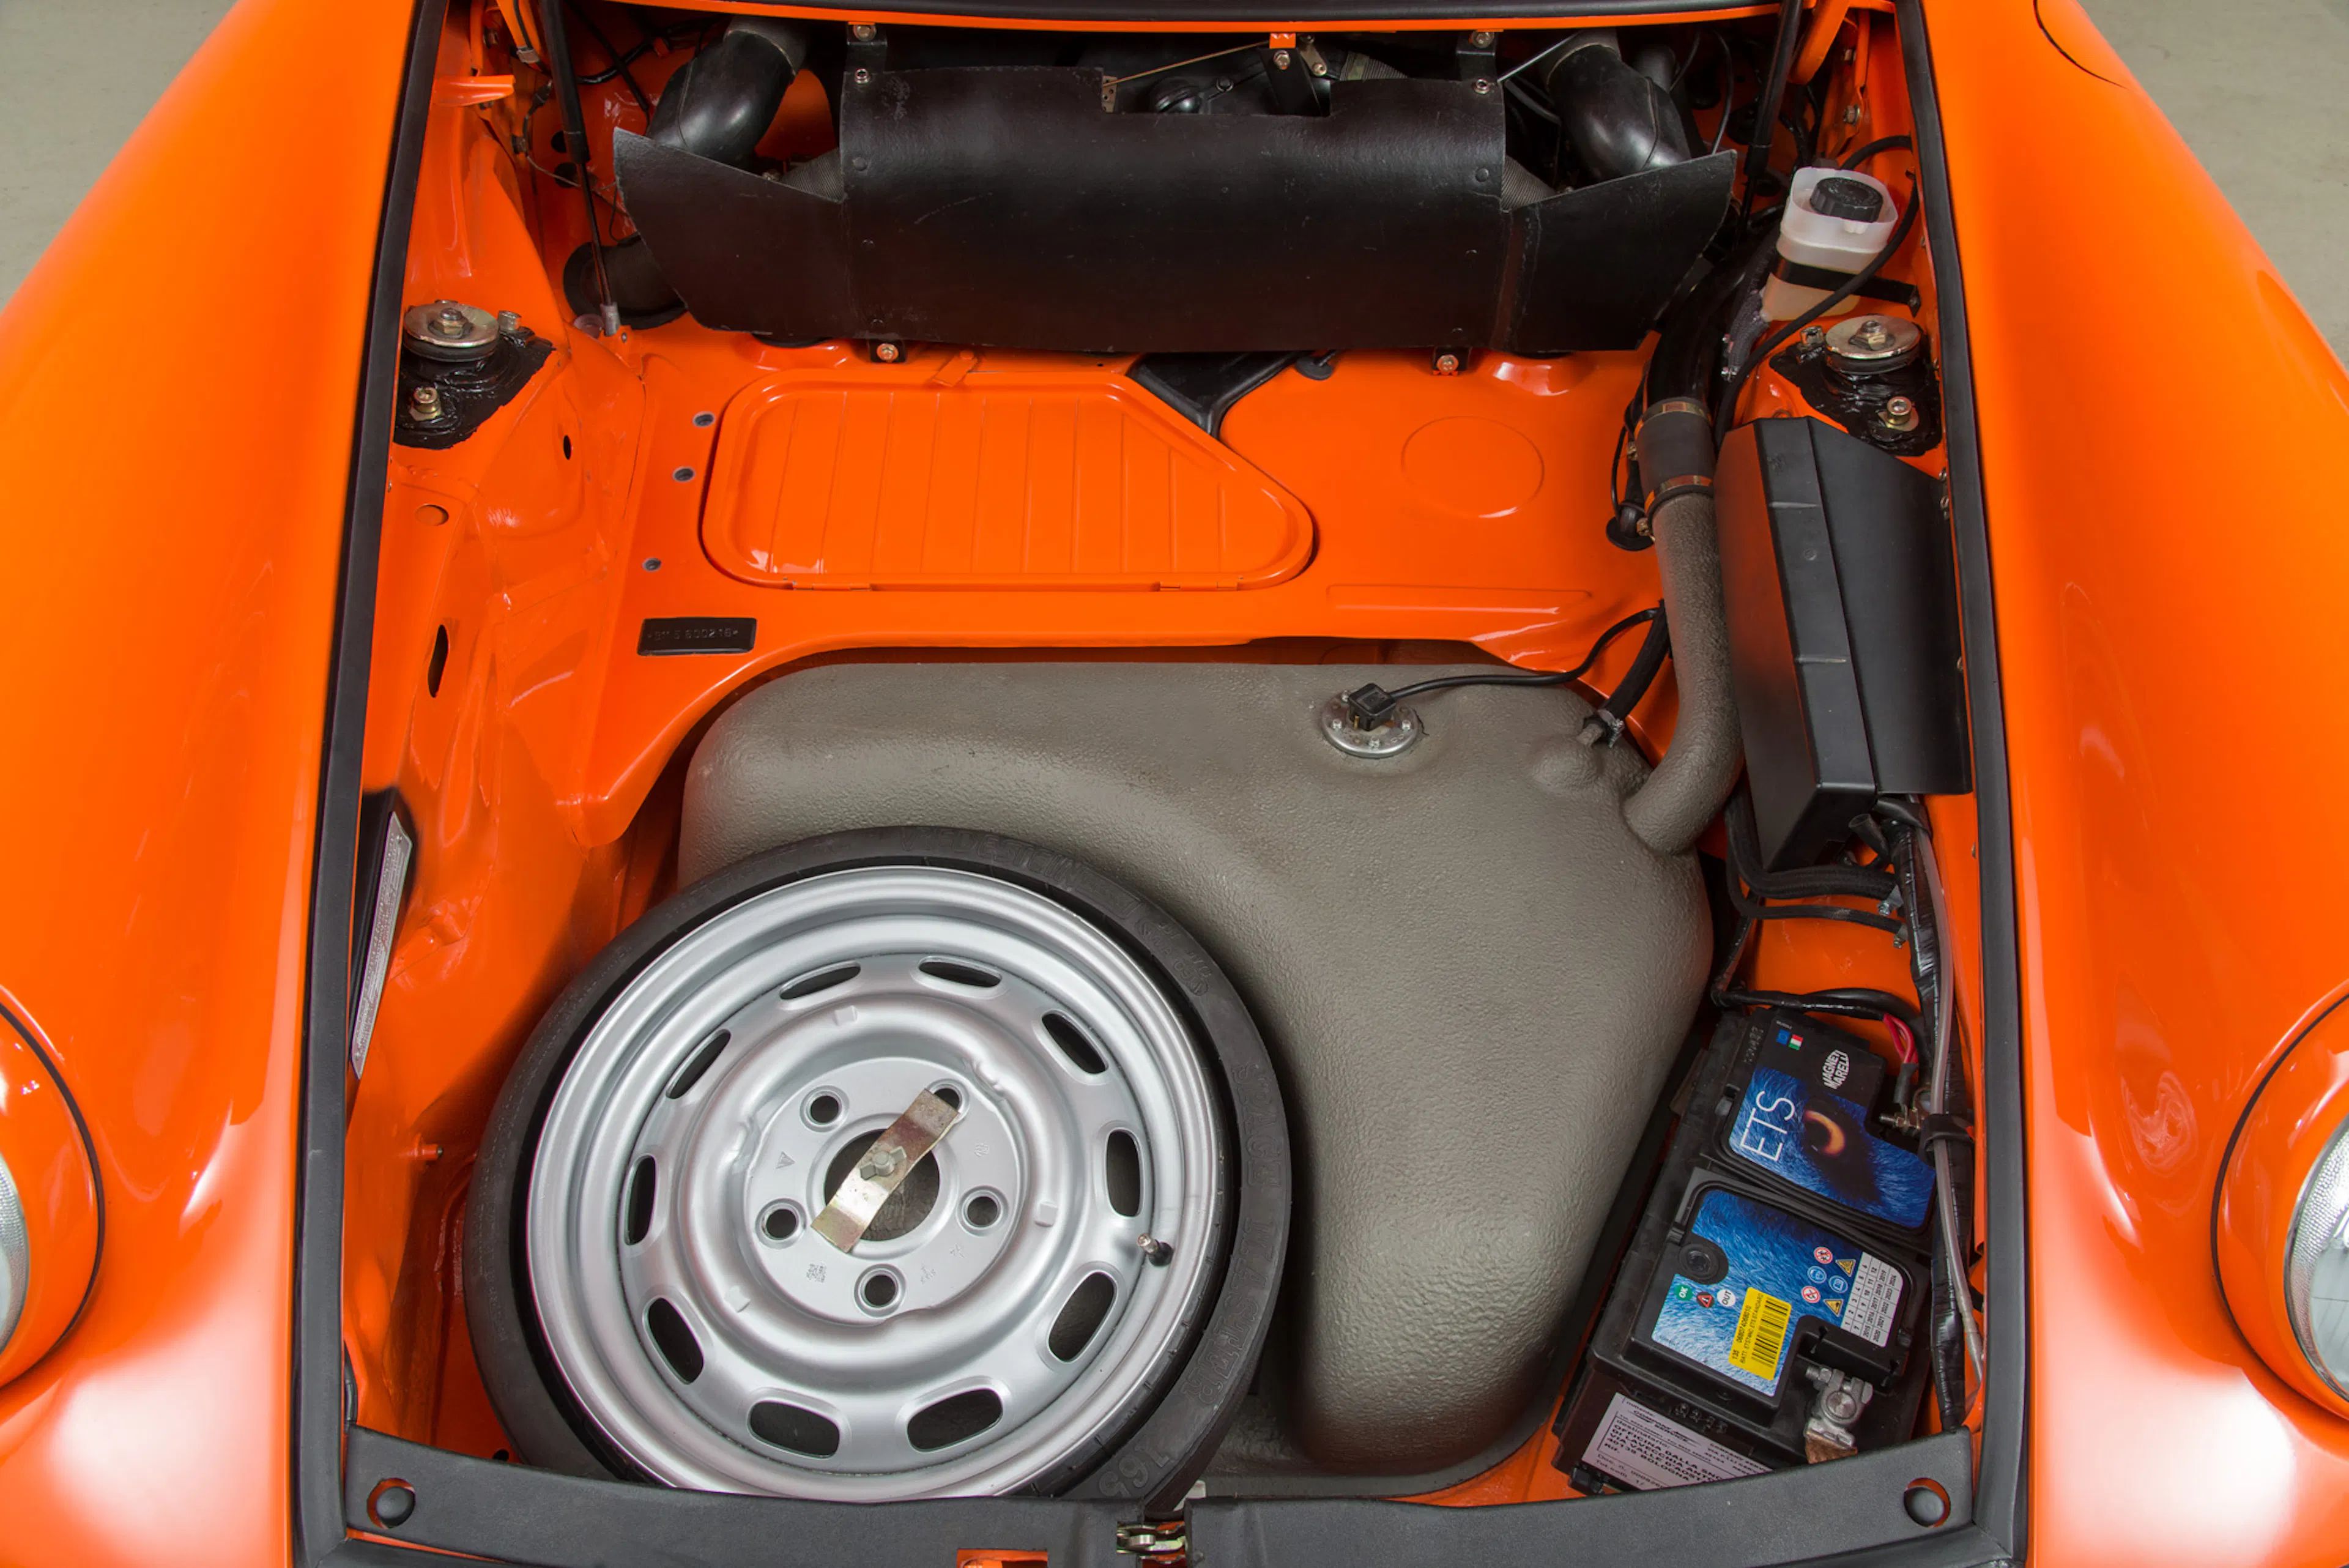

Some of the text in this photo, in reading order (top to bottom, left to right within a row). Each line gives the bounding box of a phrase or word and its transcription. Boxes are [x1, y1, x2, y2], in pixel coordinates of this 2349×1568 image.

[1822, 1049, 1843, 1088] MAGNETI
[1740, 1091, 1795, 1162] ETS
[1182, 1060, 1283, 1405] SPACE MASTER
[1679, 1286, 1688, 1298] OK
[1721, 1290, 1732, 1305] OUT
[1613, 1424, 1663, 1451] OFFICINA
[1664, 1449, 1698, 1469] DALLA
[1624, 1435, 1684, 1468] LAVECCHIA
[1629, 1443, 1663, 1462] VALLE
[1099, 1436, 1171, 1497] 165
[1639, 1453, 1690, 1482] BOLOGNA
